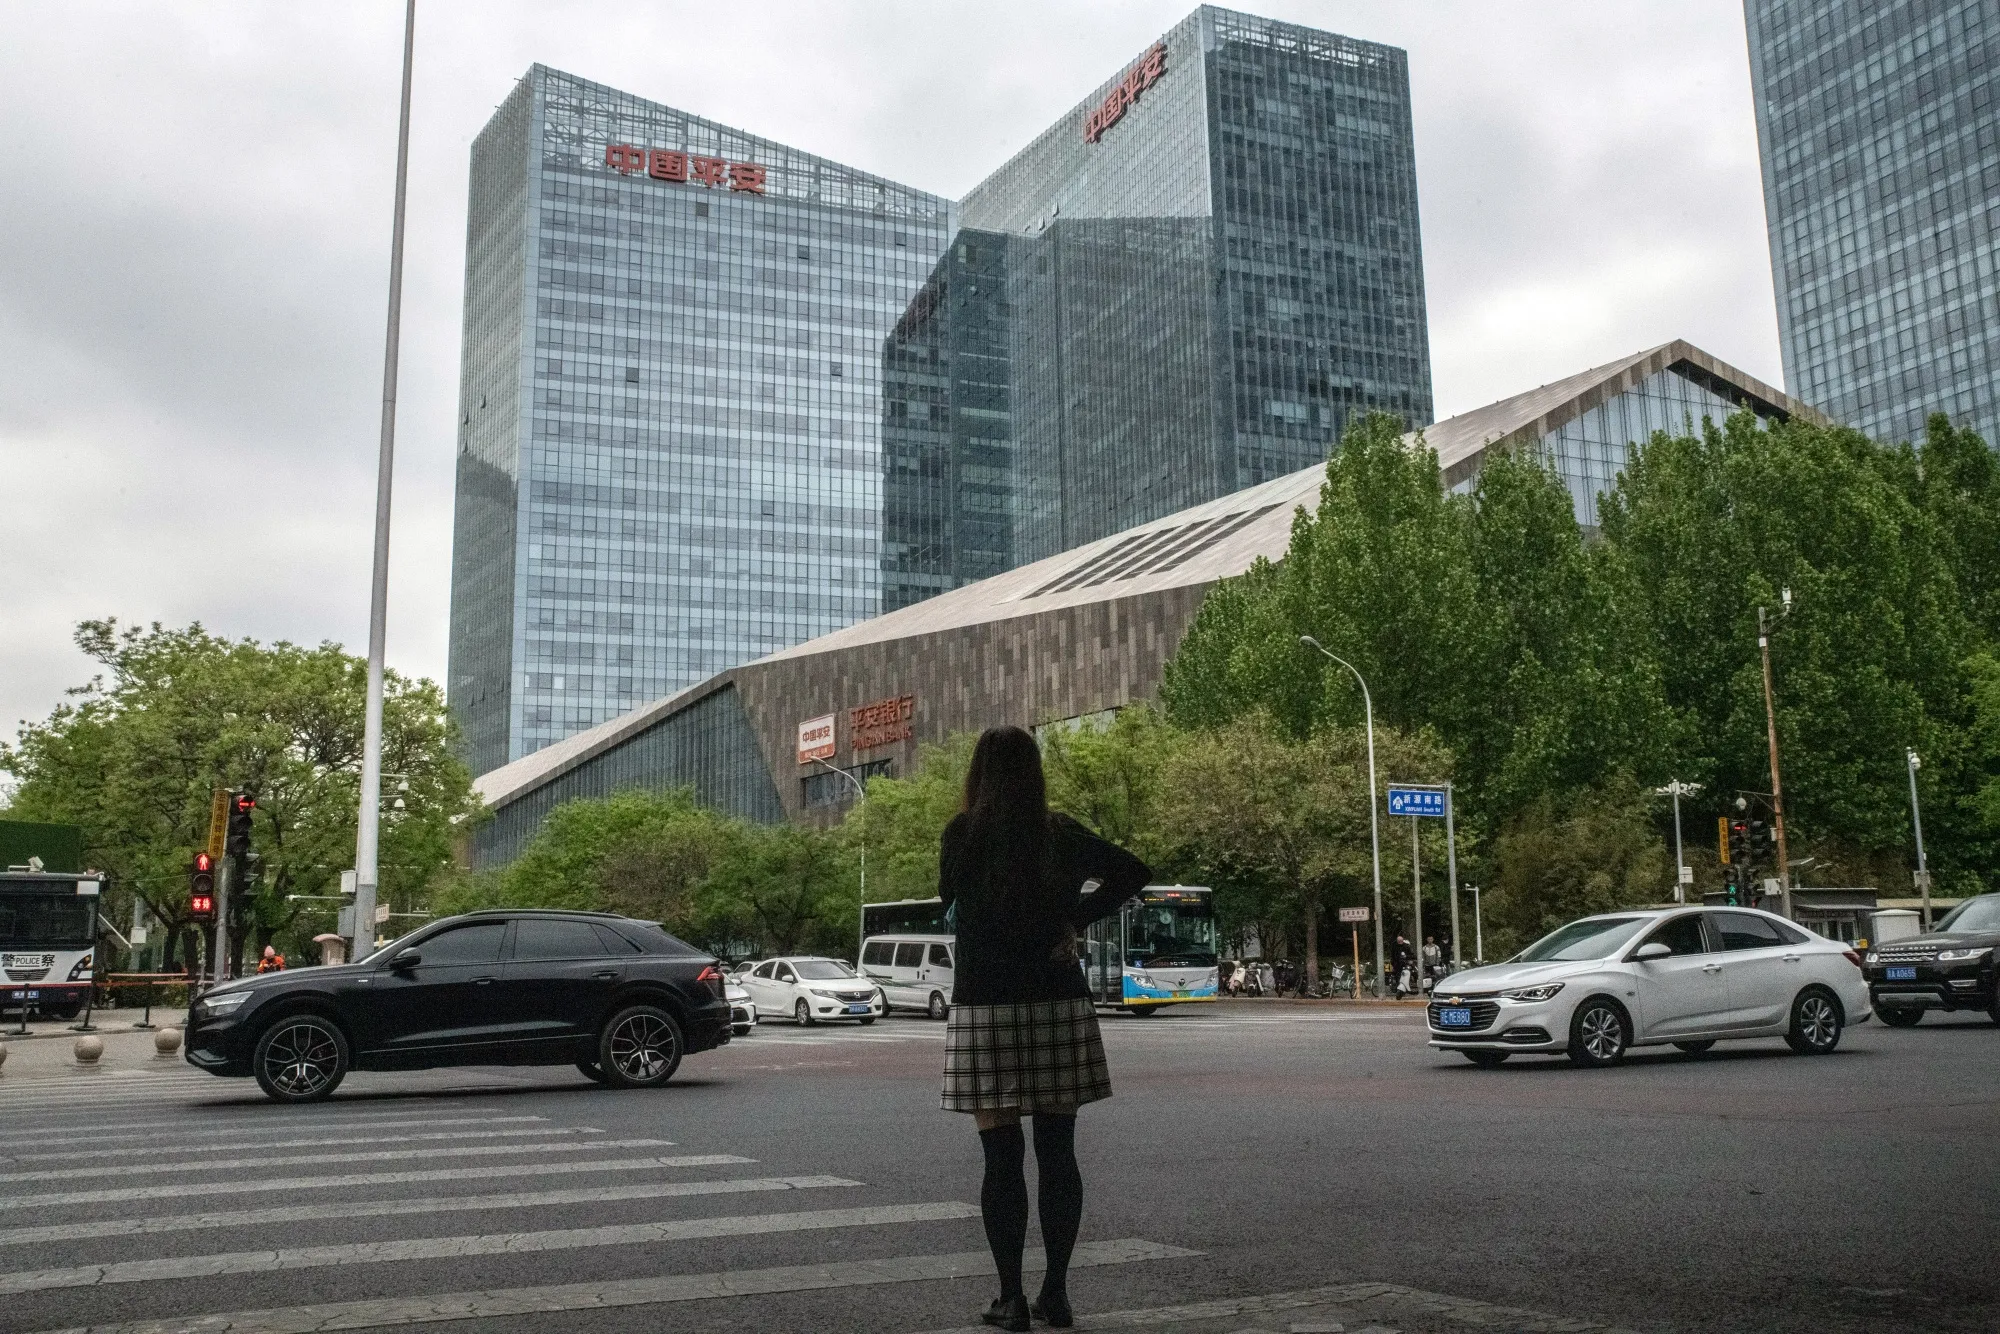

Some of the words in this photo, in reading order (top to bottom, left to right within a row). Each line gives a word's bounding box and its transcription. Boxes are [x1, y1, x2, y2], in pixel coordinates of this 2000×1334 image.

[1083, 42, 1166, 143] 中国平安
[606, 144, 766, 195] 中国平安
[850, 693, 914, 731] 平安银行
[802, 725, 830, 742] 中国平安
[886, 726, 912, 744] BANK
[1403, 794, 1441, 805] 新源南路
[192, 897, 211, 911] 等待
[1, 953, 15, 968] 警
[15, 957, 40, 965] POLICE
[41, 953, 56, 968] 察
